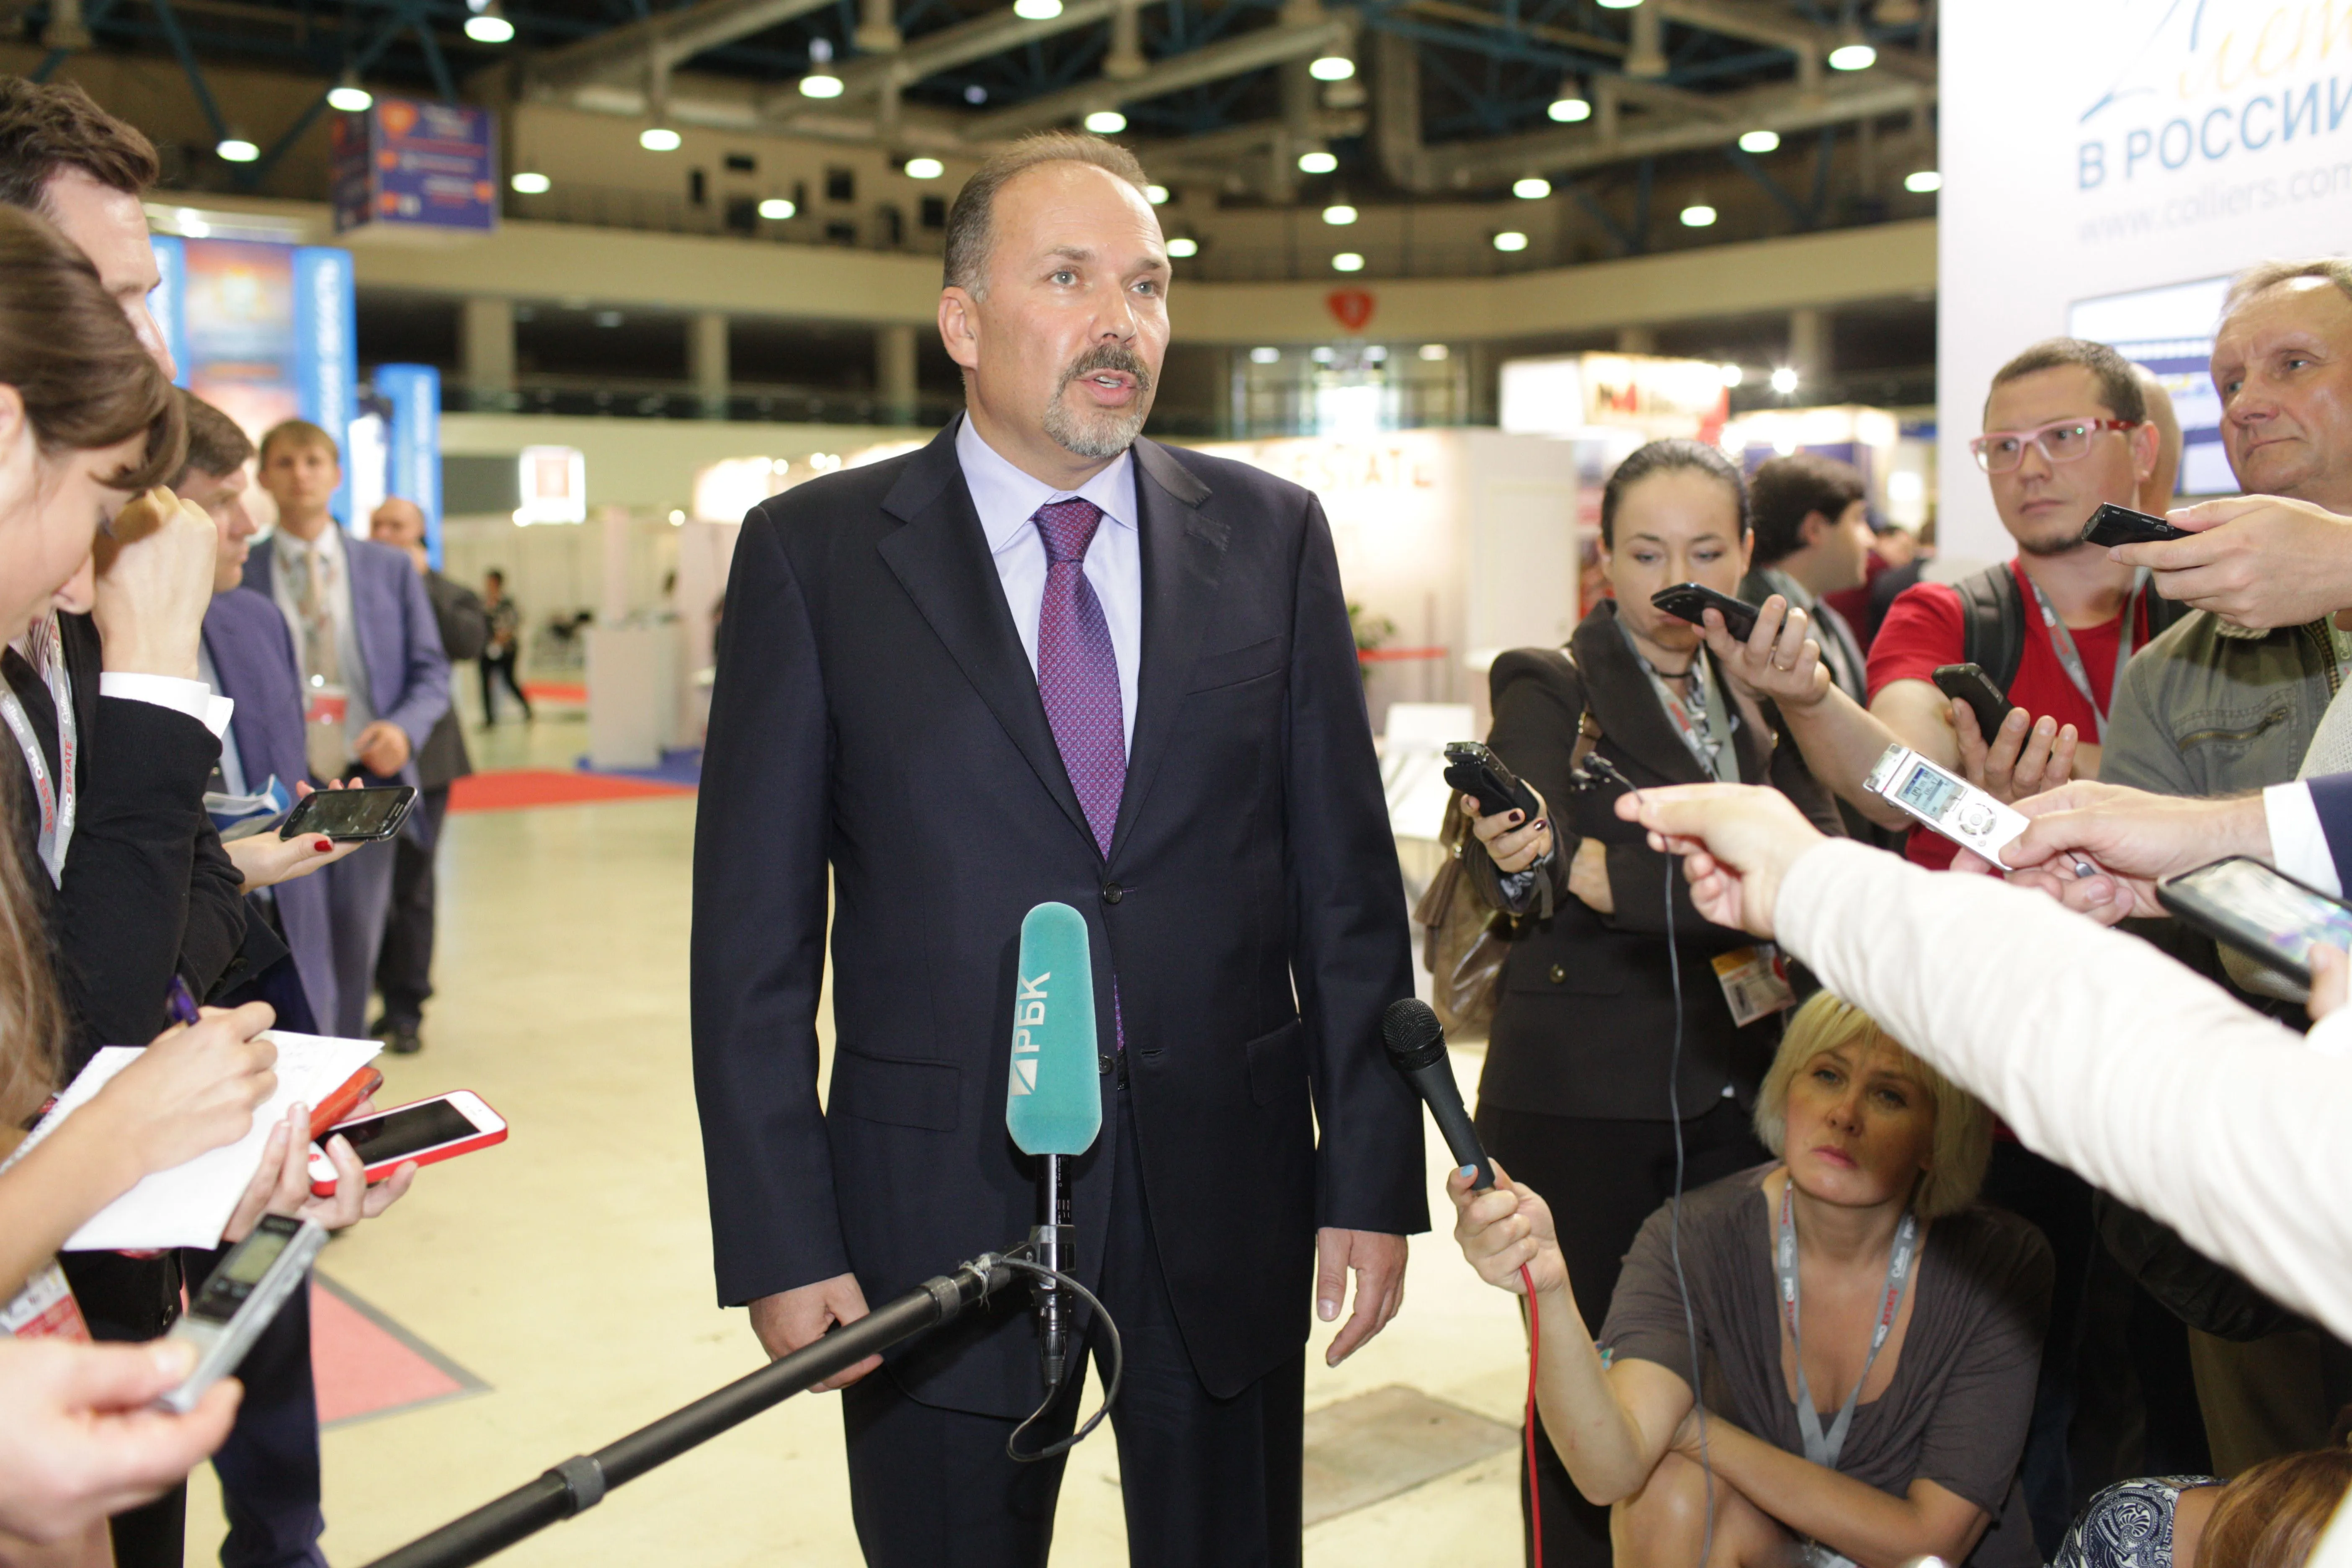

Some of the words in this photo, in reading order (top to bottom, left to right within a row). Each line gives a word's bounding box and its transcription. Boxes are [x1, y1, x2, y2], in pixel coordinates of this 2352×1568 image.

[2079, 139, 2106, 191] В
[28, 746, 53, 833] PROESTATE
[63, 740, 72, 827] PROESTATE
[1014, 972, 1050, 1053] РБК
